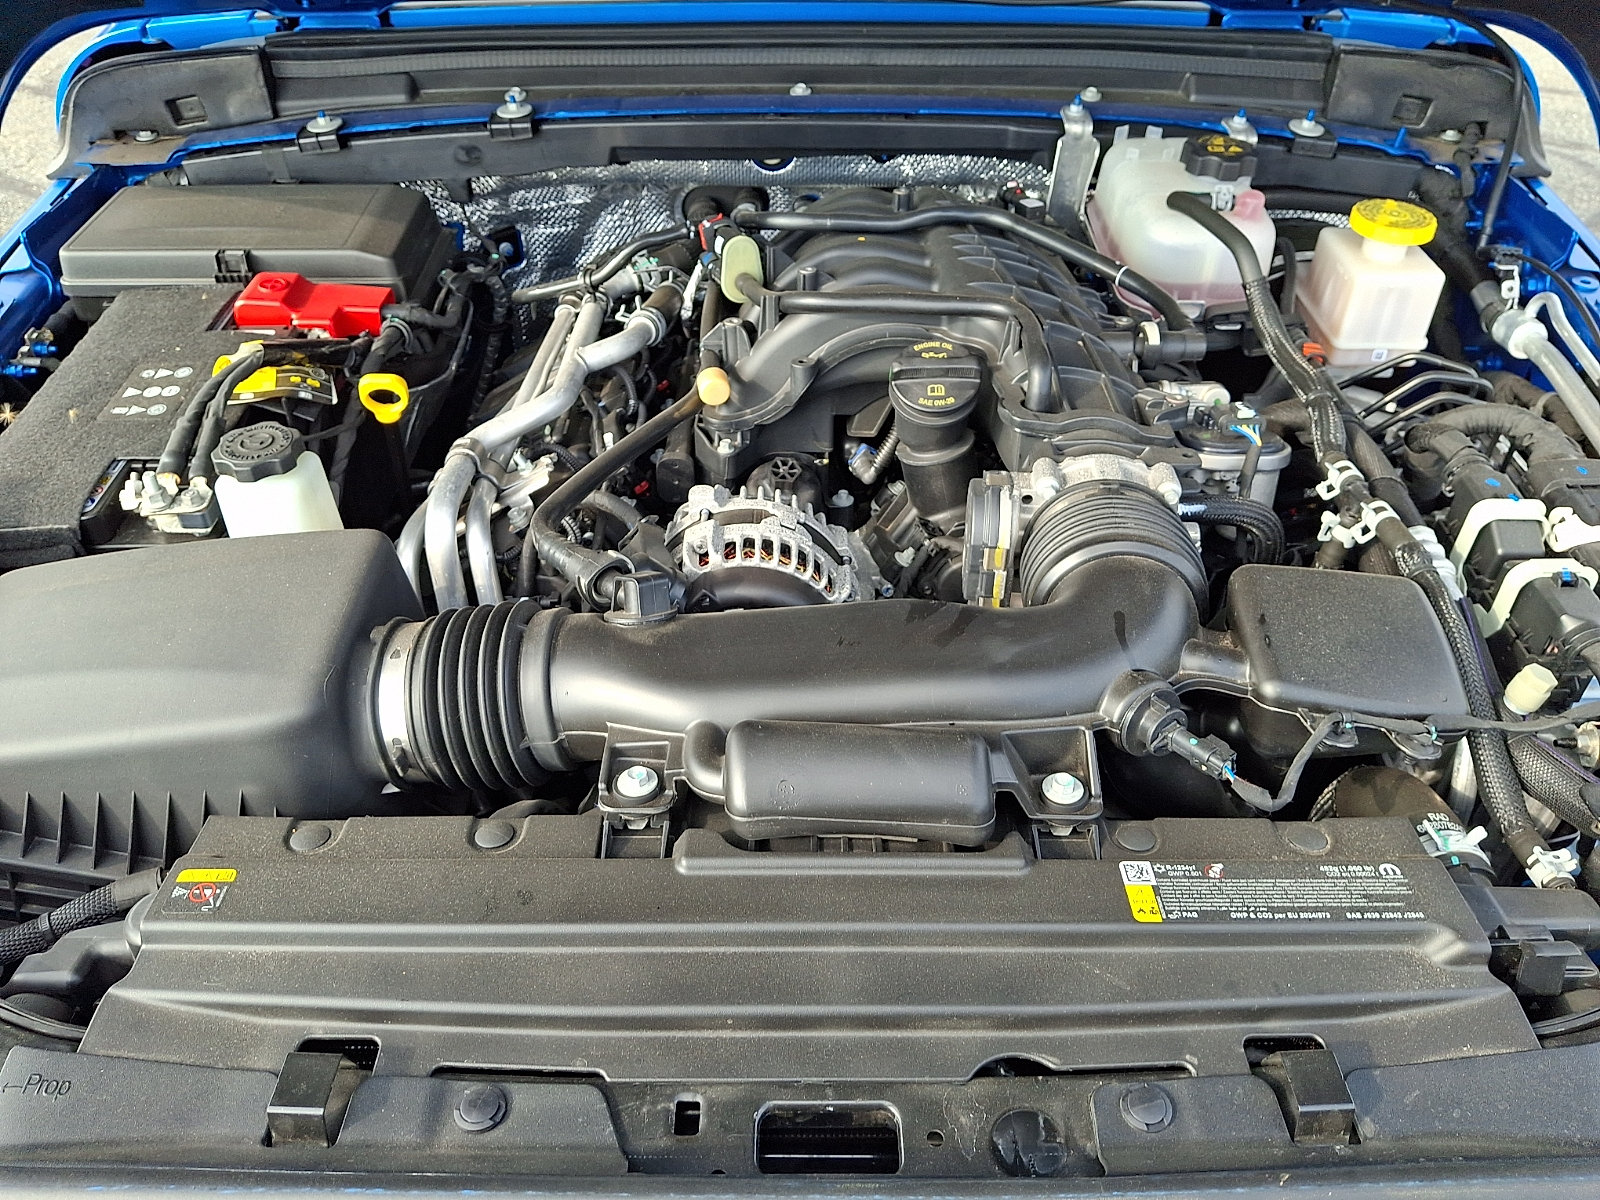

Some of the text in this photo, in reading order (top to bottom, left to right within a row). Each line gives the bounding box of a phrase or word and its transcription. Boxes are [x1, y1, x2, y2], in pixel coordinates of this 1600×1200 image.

[913, 341, 954, 352] ENGINE OIL
[918, 396, 956, 406] SAE 0W-20
[1427, 812, 1450, 822] RAD
[22, 1073, 72, 1103] Prop
